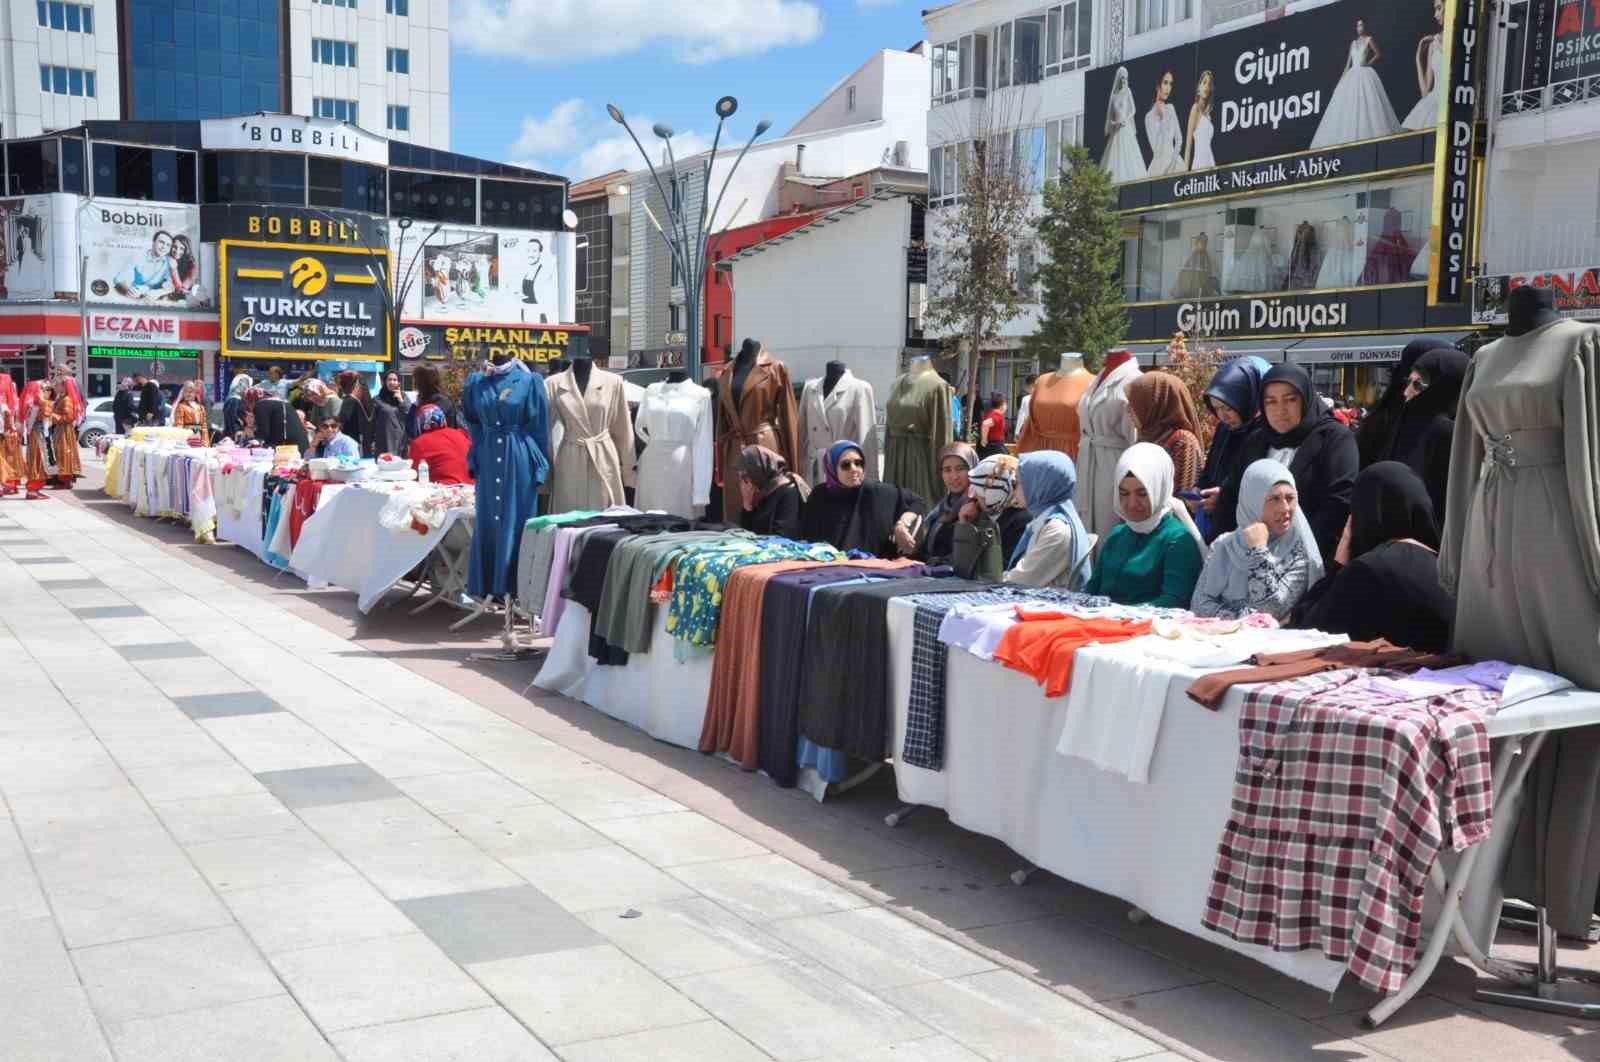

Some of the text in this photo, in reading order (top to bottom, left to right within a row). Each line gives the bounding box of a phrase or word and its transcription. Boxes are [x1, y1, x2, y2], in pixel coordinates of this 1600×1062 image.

[1234, 42, 1310, 85] Giyim
[1220, 90, 1321, 133] Dünyası
[1173, 174, 1221, 197] Gelinlik
[1231, 164, 1287, 189] Nişanlık
[101, 208, 164, 228] Bobbili
[242, 296, 372, 320] TURKCELL
[1176, 299, 1347, 337] Giyim Dünyası
[94, 316, 174, 334] ECZANE
[445, 327, 569, 345] ŞAHANLAR
